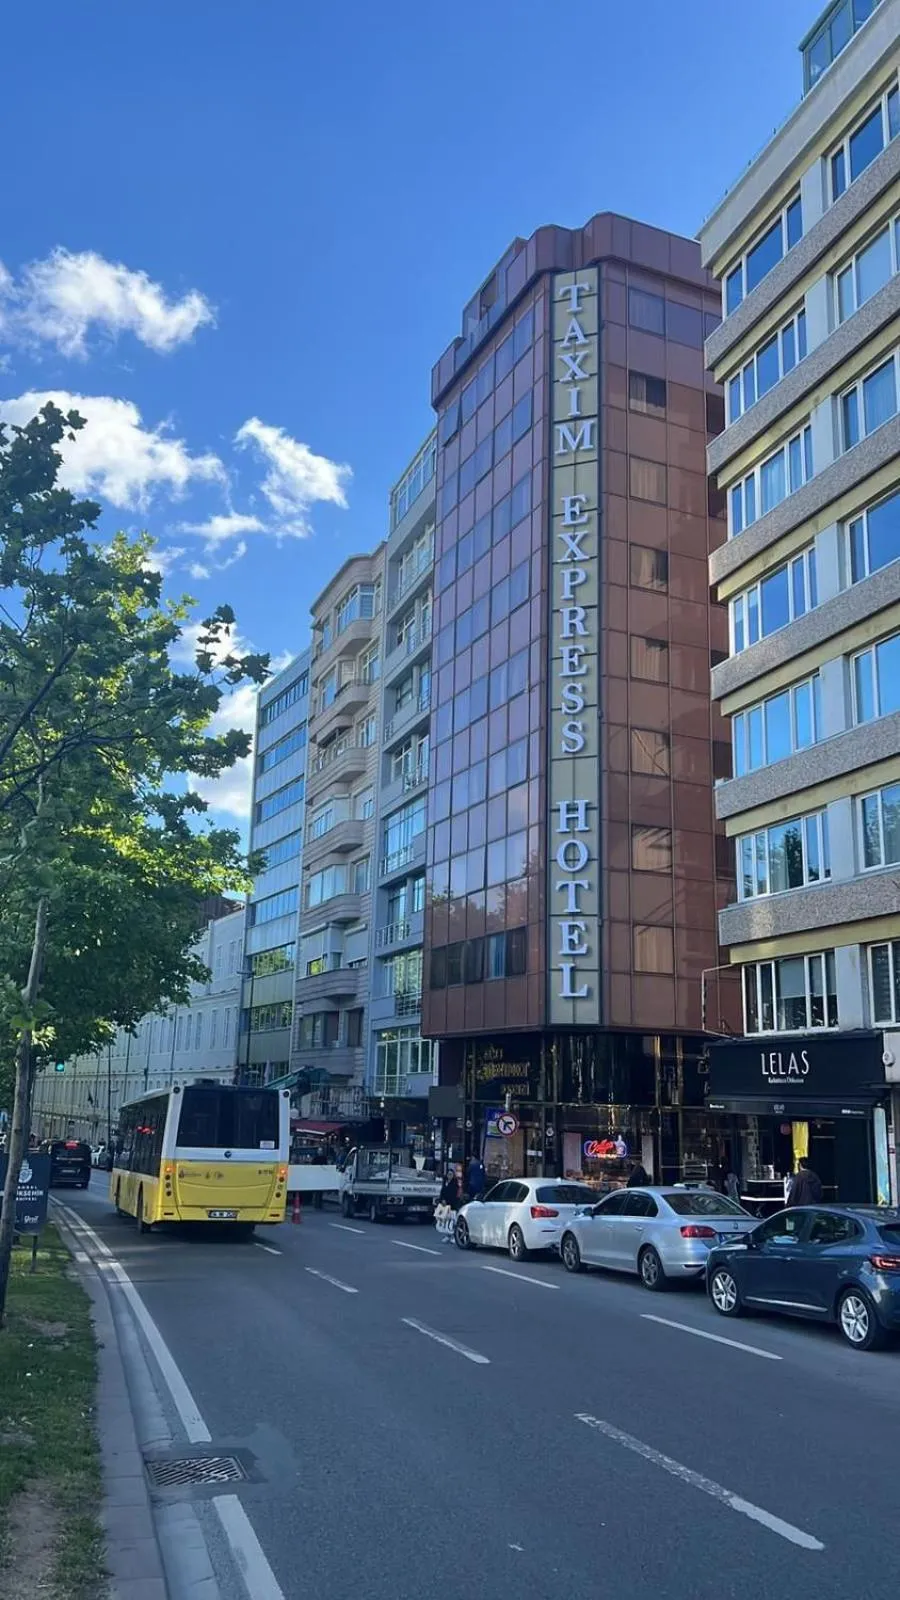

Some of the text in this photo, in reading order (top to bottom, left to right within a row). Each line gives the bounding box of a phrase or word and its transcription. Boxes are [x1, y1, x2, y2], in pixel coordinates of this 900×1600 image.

[554, 283, 595, 998] TAXIM EXPRESS HOTEL
[760, 1050, 810, 1075] LELAS
